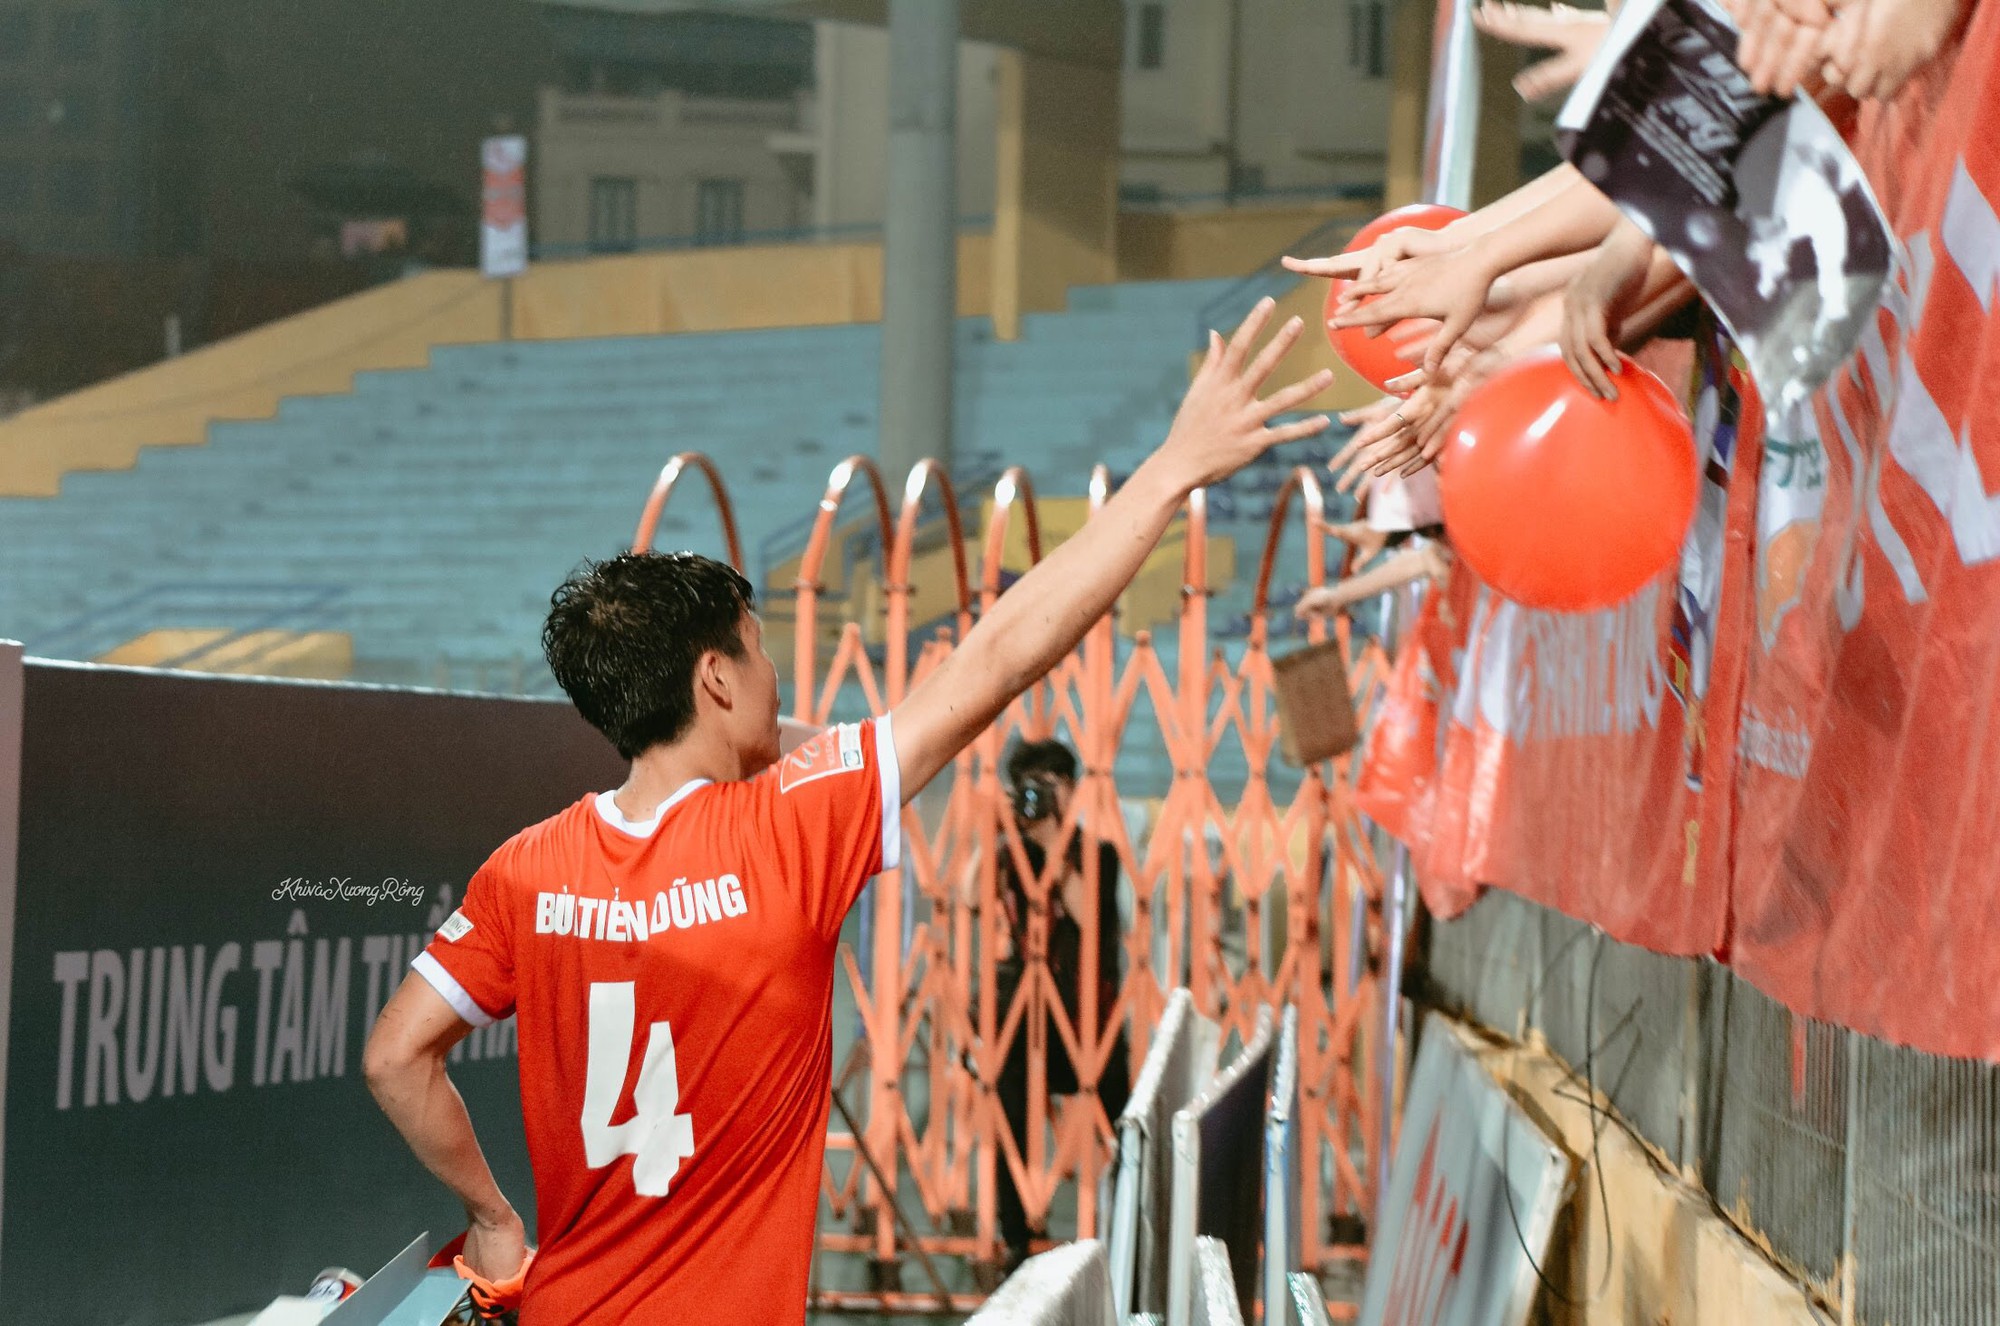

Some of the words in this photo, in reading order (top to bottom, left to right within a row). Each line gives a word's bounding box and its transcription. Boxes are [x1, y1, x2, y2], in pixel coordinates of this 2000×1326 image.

[650, 873, 749, 935] DŨNG
[53, 942, 242, 1110] TRUNG
[252, 908, 352, 1087] TÂM
[580, 980, 696, 1198] 4
